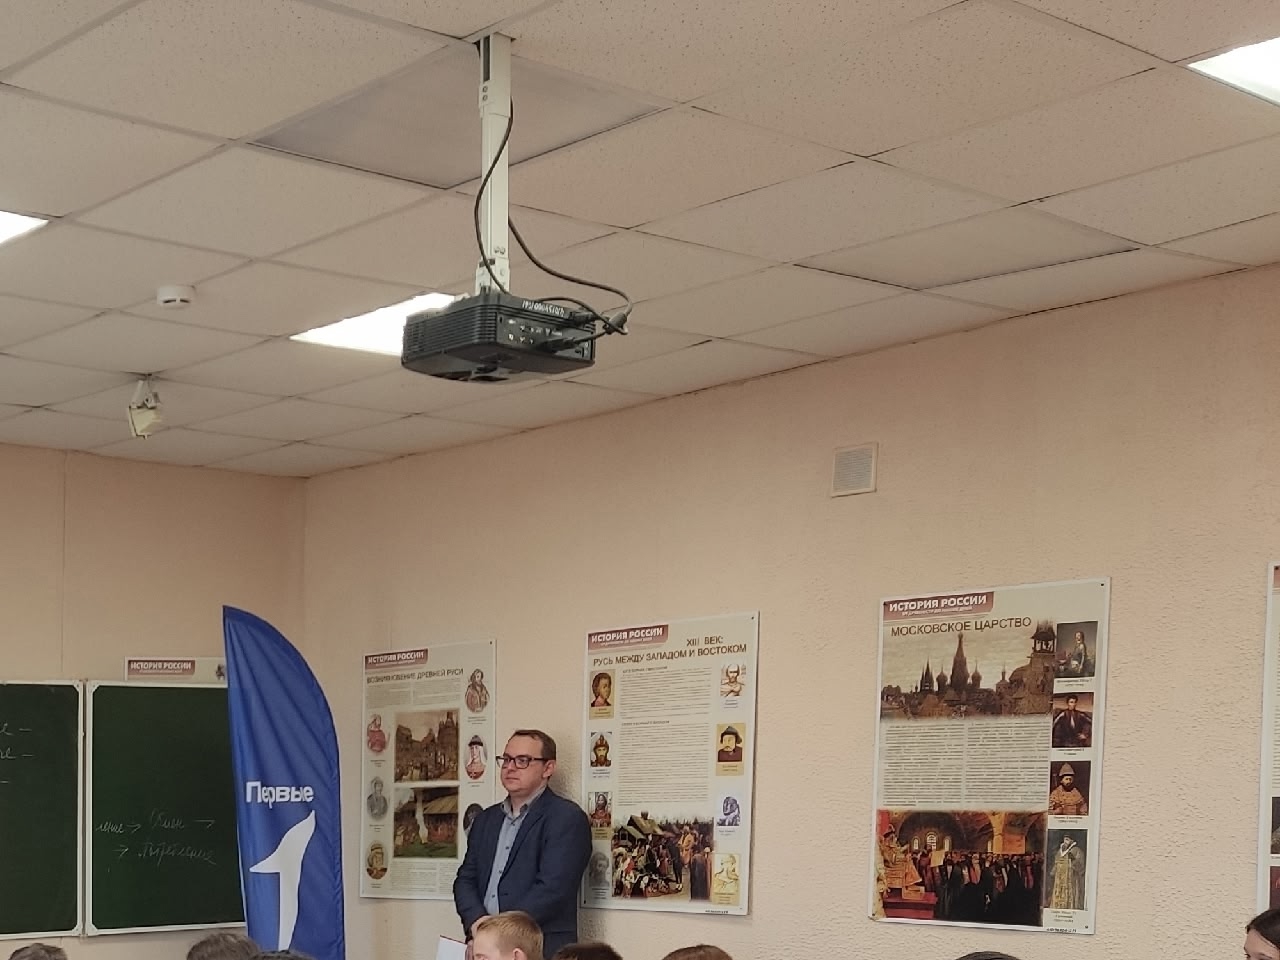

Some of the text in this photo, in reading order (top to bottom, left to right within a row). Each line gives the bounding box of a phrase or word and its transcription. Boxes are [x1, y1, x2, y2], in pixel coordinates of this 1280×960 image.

[889, 599, 939, 612] ИСТОРИЯ
[940, 594, 987, 608] РОССИИ
[591, 631, 628, 643] ИСТОРИЯ
[628, 627, 663, 639] РОССИИ
[891, 617, 1032, 636] МОСКОВСКОЕ ЦАРСТВО
[368, 654, 397, 664] ИСТОРИЯ
[397, 651, 424, 661] РОССИИ
[593, 644, 747, 667] РУСЬ МЕЖДУ ЗАПАДОМ И ВОСТОКОМ
[130, 661, 192, 670] ИСТОРИЯ РОССИИ
[417, 669, 446, 680] ДРЕВНЕЙ
[446, 668, 464, 676] РУСИ
[245, 780, 315, 810] Первые
